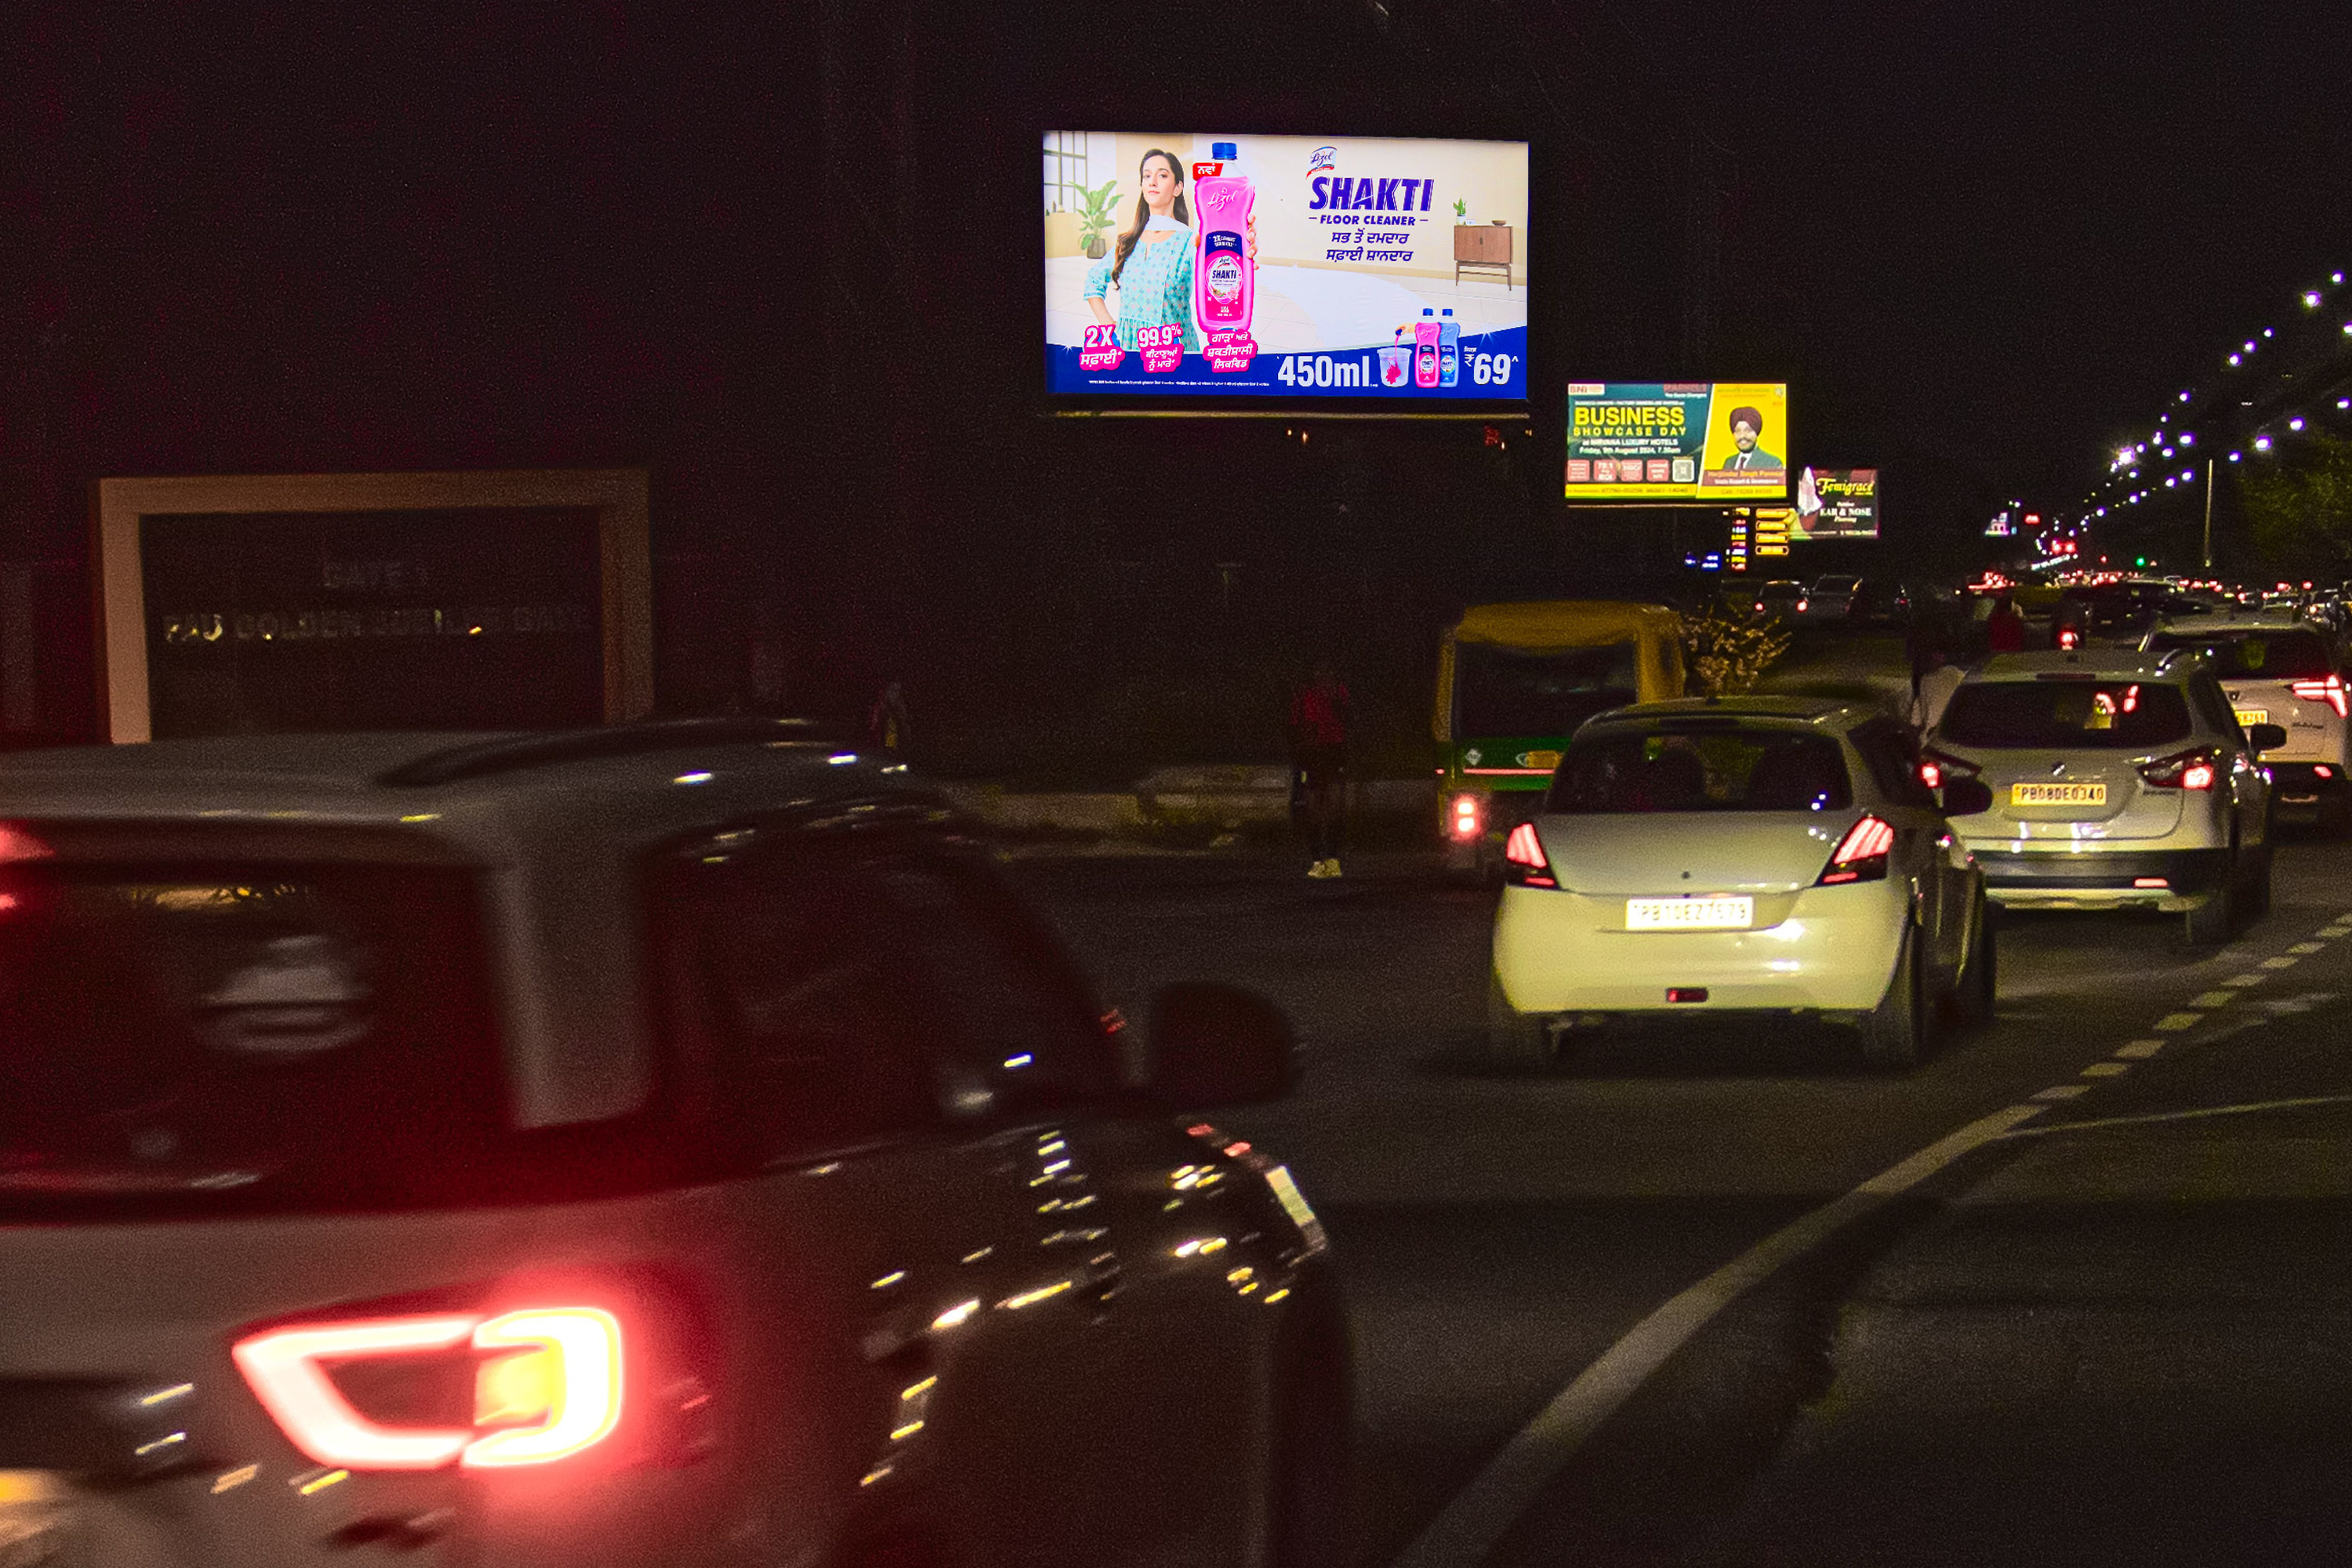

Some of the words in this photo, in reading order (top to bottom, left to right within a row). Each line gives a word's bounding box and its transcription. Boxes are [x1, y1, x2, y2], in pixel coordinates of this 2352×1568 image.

[1197, 162, 1216, 175] ਨਵਾਂ
[1207, 187, 1238, 211] Lizol
[1309, 176, 1435, 212] SHAKTI
[1320, 215, 1359, 225] FLOOR
[1363, 215, 1416, 226] CLEANER
[1331, 232, 1352, 244] ਸਭ
[1353, 227, 1366, 244] ਤੋਂ
[1367, 232, 1410, 245] ਦਮਦਾਰ
[1326, 246, 1363, 263] ਸਫ਼ਾਈ
[1366, 250, 1414, 263] ਸ਼ਾਨਦਾਰ
[1212, 270, 1236, 279] SHAKTI
[1086, 326, 1113, 348] 2X
[1138, 325, 1181, 348] 99.9%
[1277, 355, 1370, 387] 450ml
[1574, 407, 1685, 426] BUSINESS
[1573, 426, 1653, 437] SHOWCASE
[1660, 426, 1686, 436] DAY
